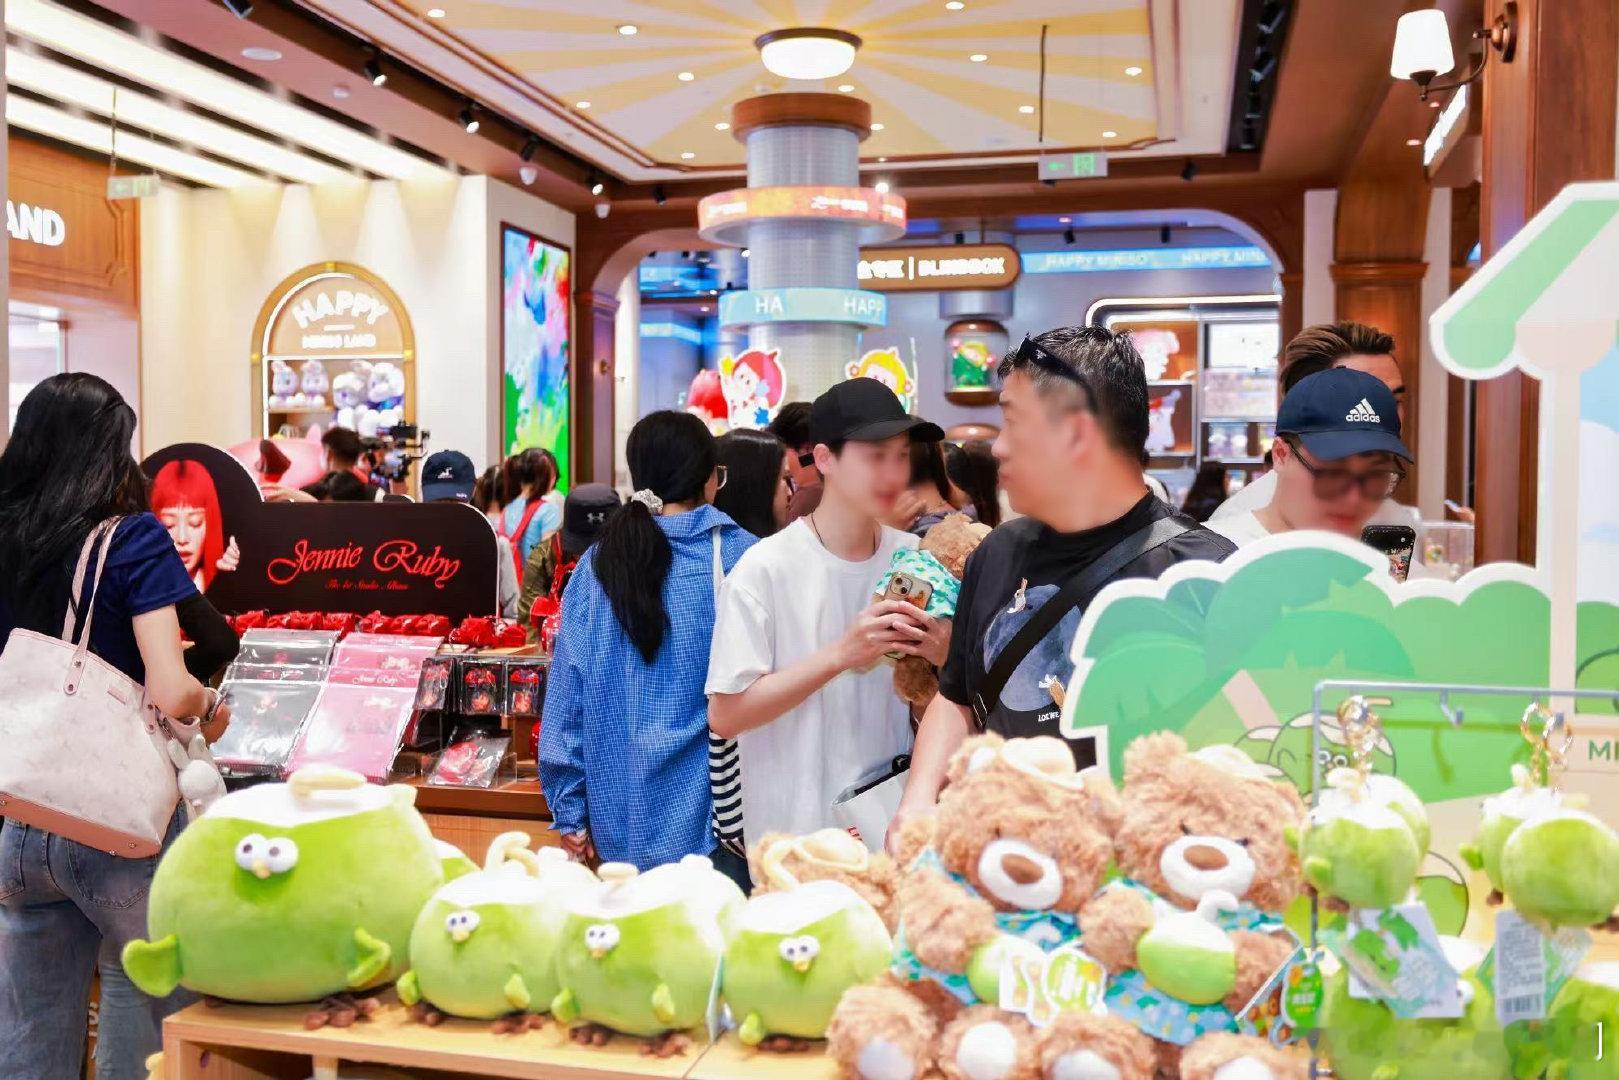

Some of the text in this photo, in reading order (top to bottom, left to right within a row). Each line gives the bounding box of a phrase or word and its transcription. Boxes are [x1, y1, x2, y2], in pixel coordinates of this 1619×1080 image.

[291, 290, 390, 329] HAPPY
[754, 295, 784, 315] HA
[1345, 412, 1380, 423] adidas
[267, 539, 460, 589] Jennie Ruby
